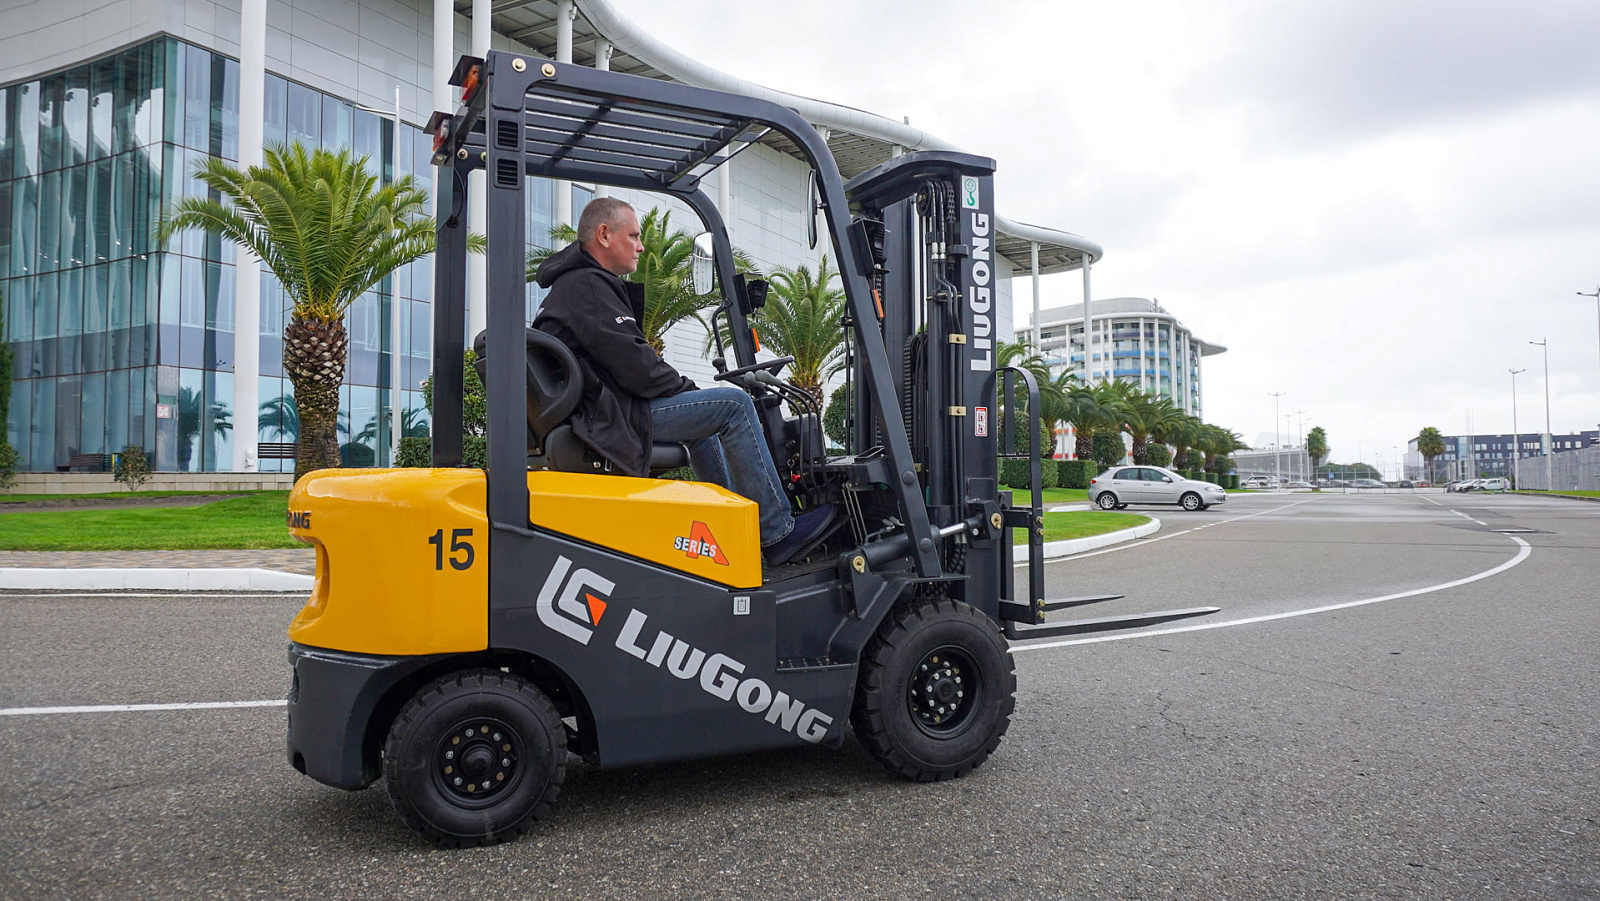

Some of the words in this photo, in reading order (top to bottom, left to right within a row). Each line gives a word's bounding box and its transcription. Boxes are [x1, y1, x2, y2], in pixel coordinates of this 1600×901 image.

[970, 212, 991, 371] LIUGONG
[428, 528, 475, 571] 15
[674, 536, 717, 558] SERIES
[686, 520, 730, 566] A
[615, 608, 833, 744] LIUGONG
